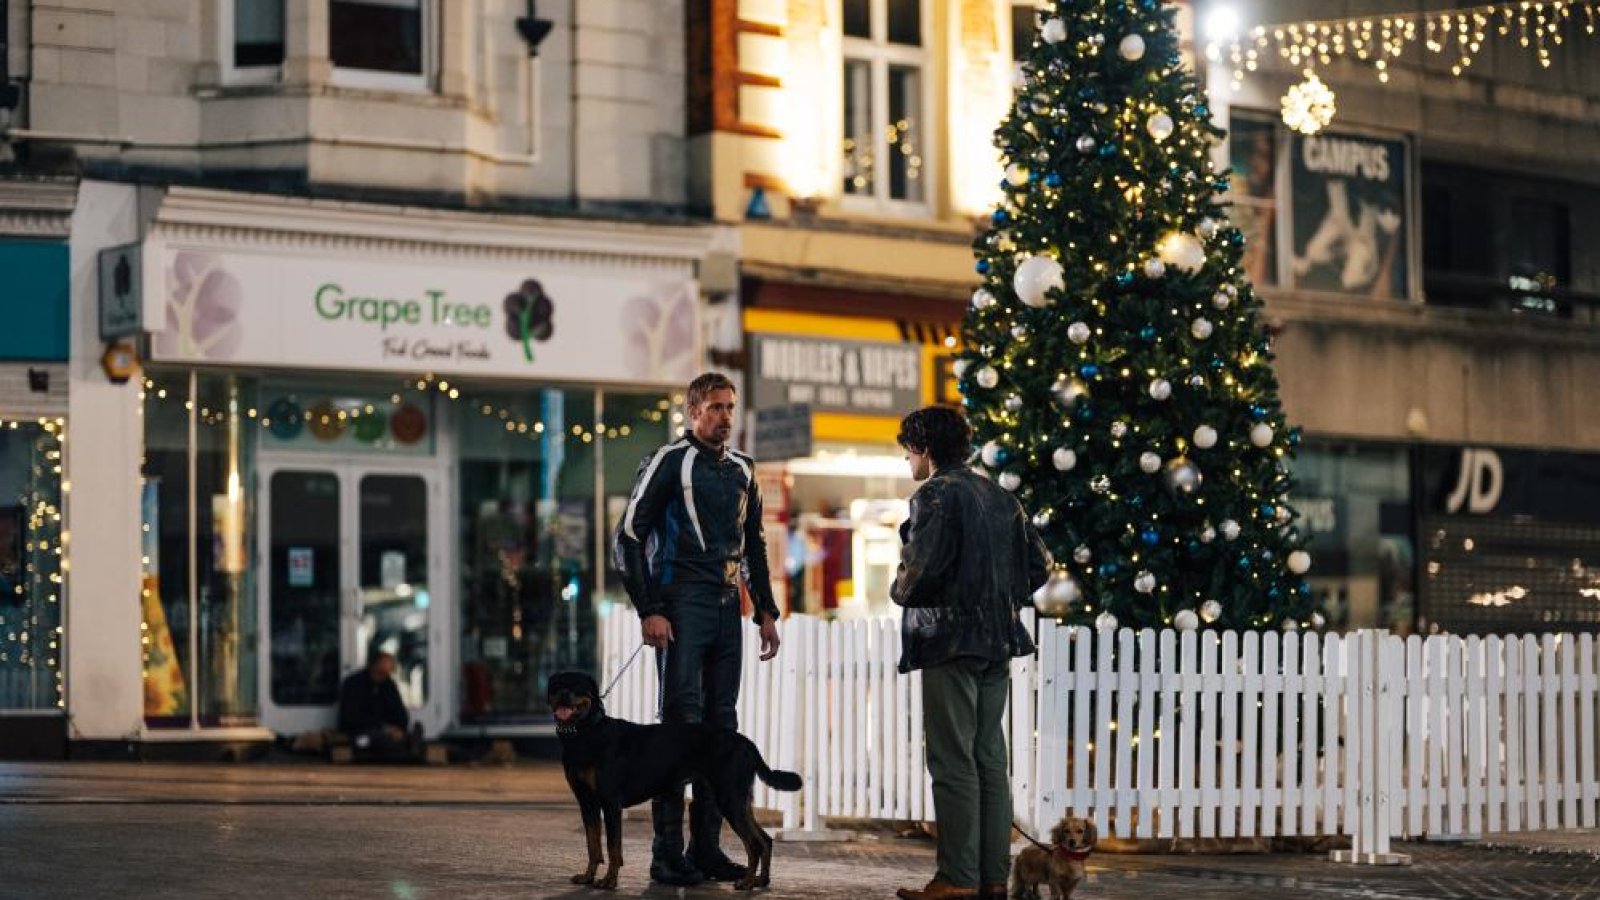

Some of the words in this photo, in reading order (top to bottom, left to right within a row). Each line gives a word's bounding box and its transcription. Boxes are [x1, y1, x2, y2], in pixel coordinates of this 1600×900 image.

[1303, 134, 1389, 182] CAMPUS
[314, 283, 421, 331] Grape
[425, 290, 492, 328] Tree
[1447, 448, 1503, 513] JD
